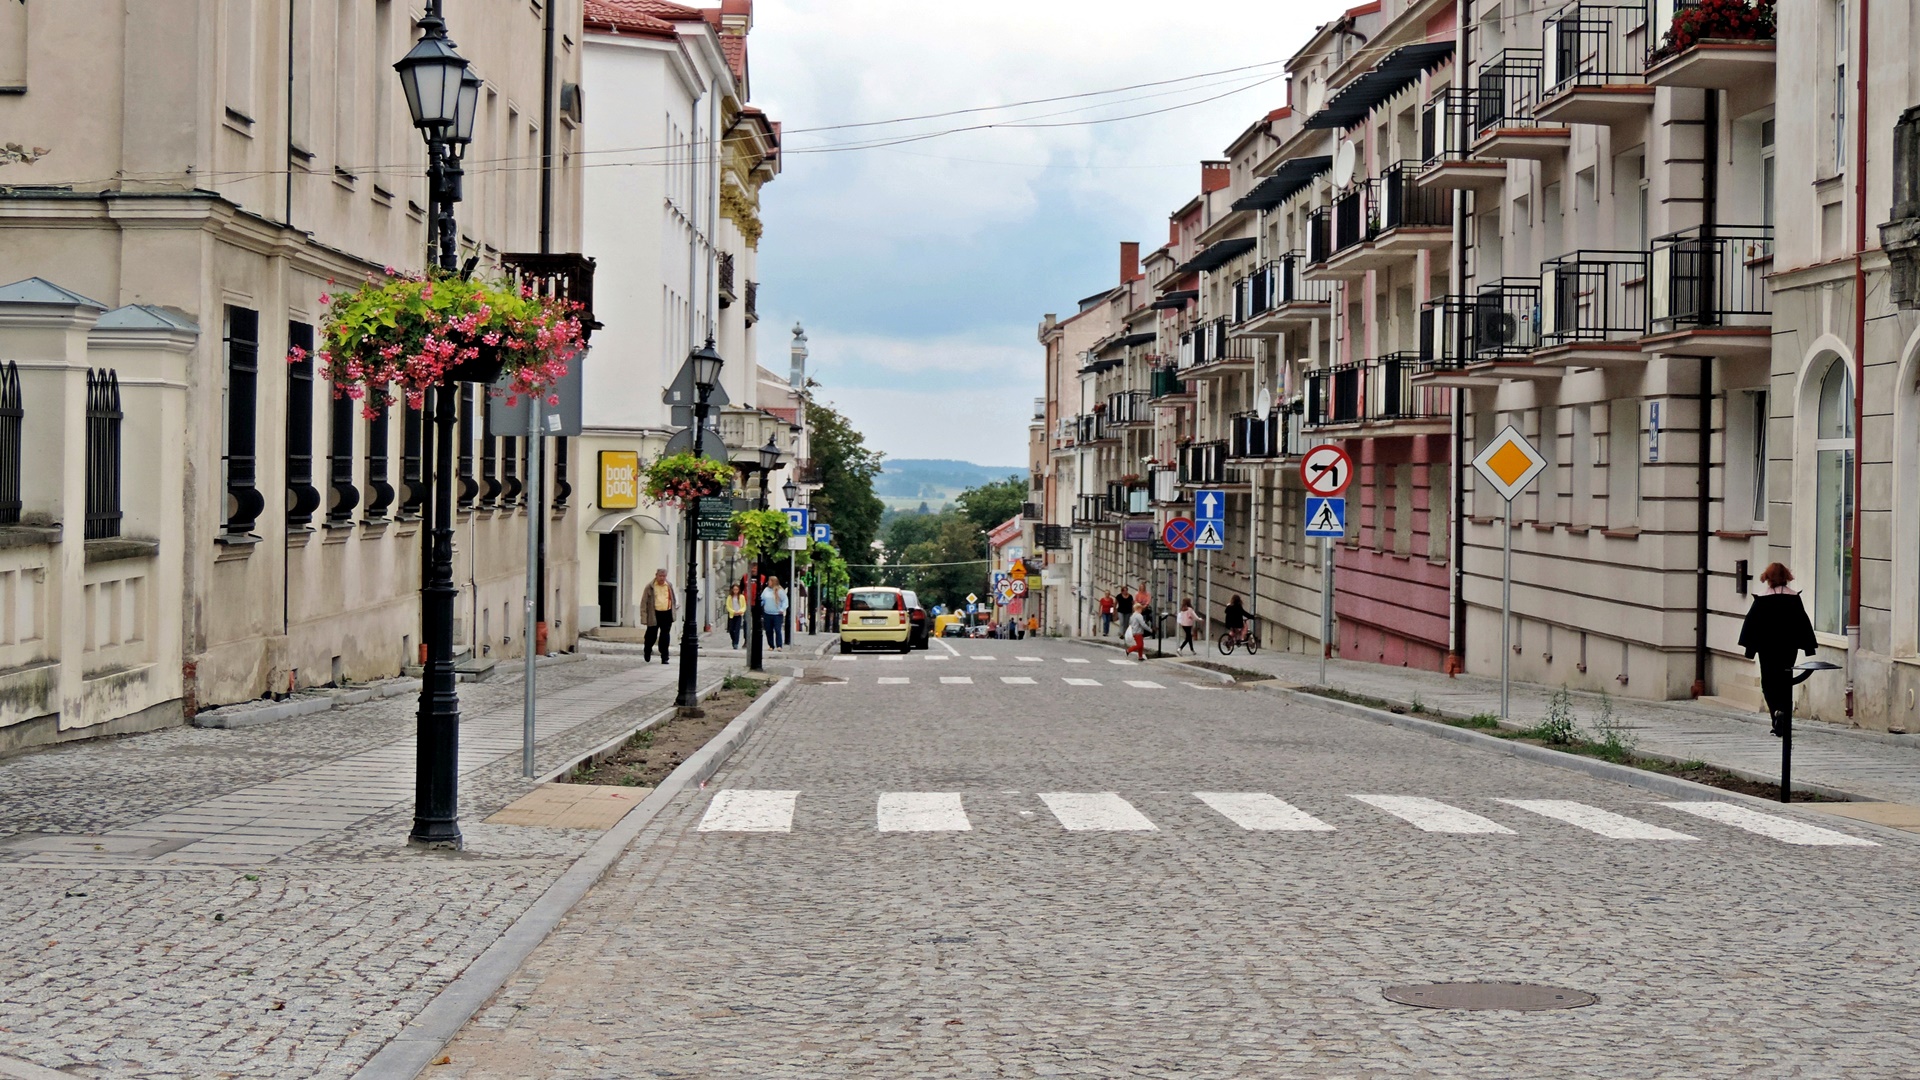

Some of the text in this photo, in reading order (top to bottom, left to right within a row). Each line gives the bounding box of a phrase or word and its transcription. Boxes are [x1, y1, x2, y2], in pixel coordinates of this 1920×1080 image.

[606, 464, 633, 480] book
[606, 481, 633, 497] book
[814, 527, 826, 542] P
[1013, 583, 1024, 591] 20
[969, 605, 975, 613] P
